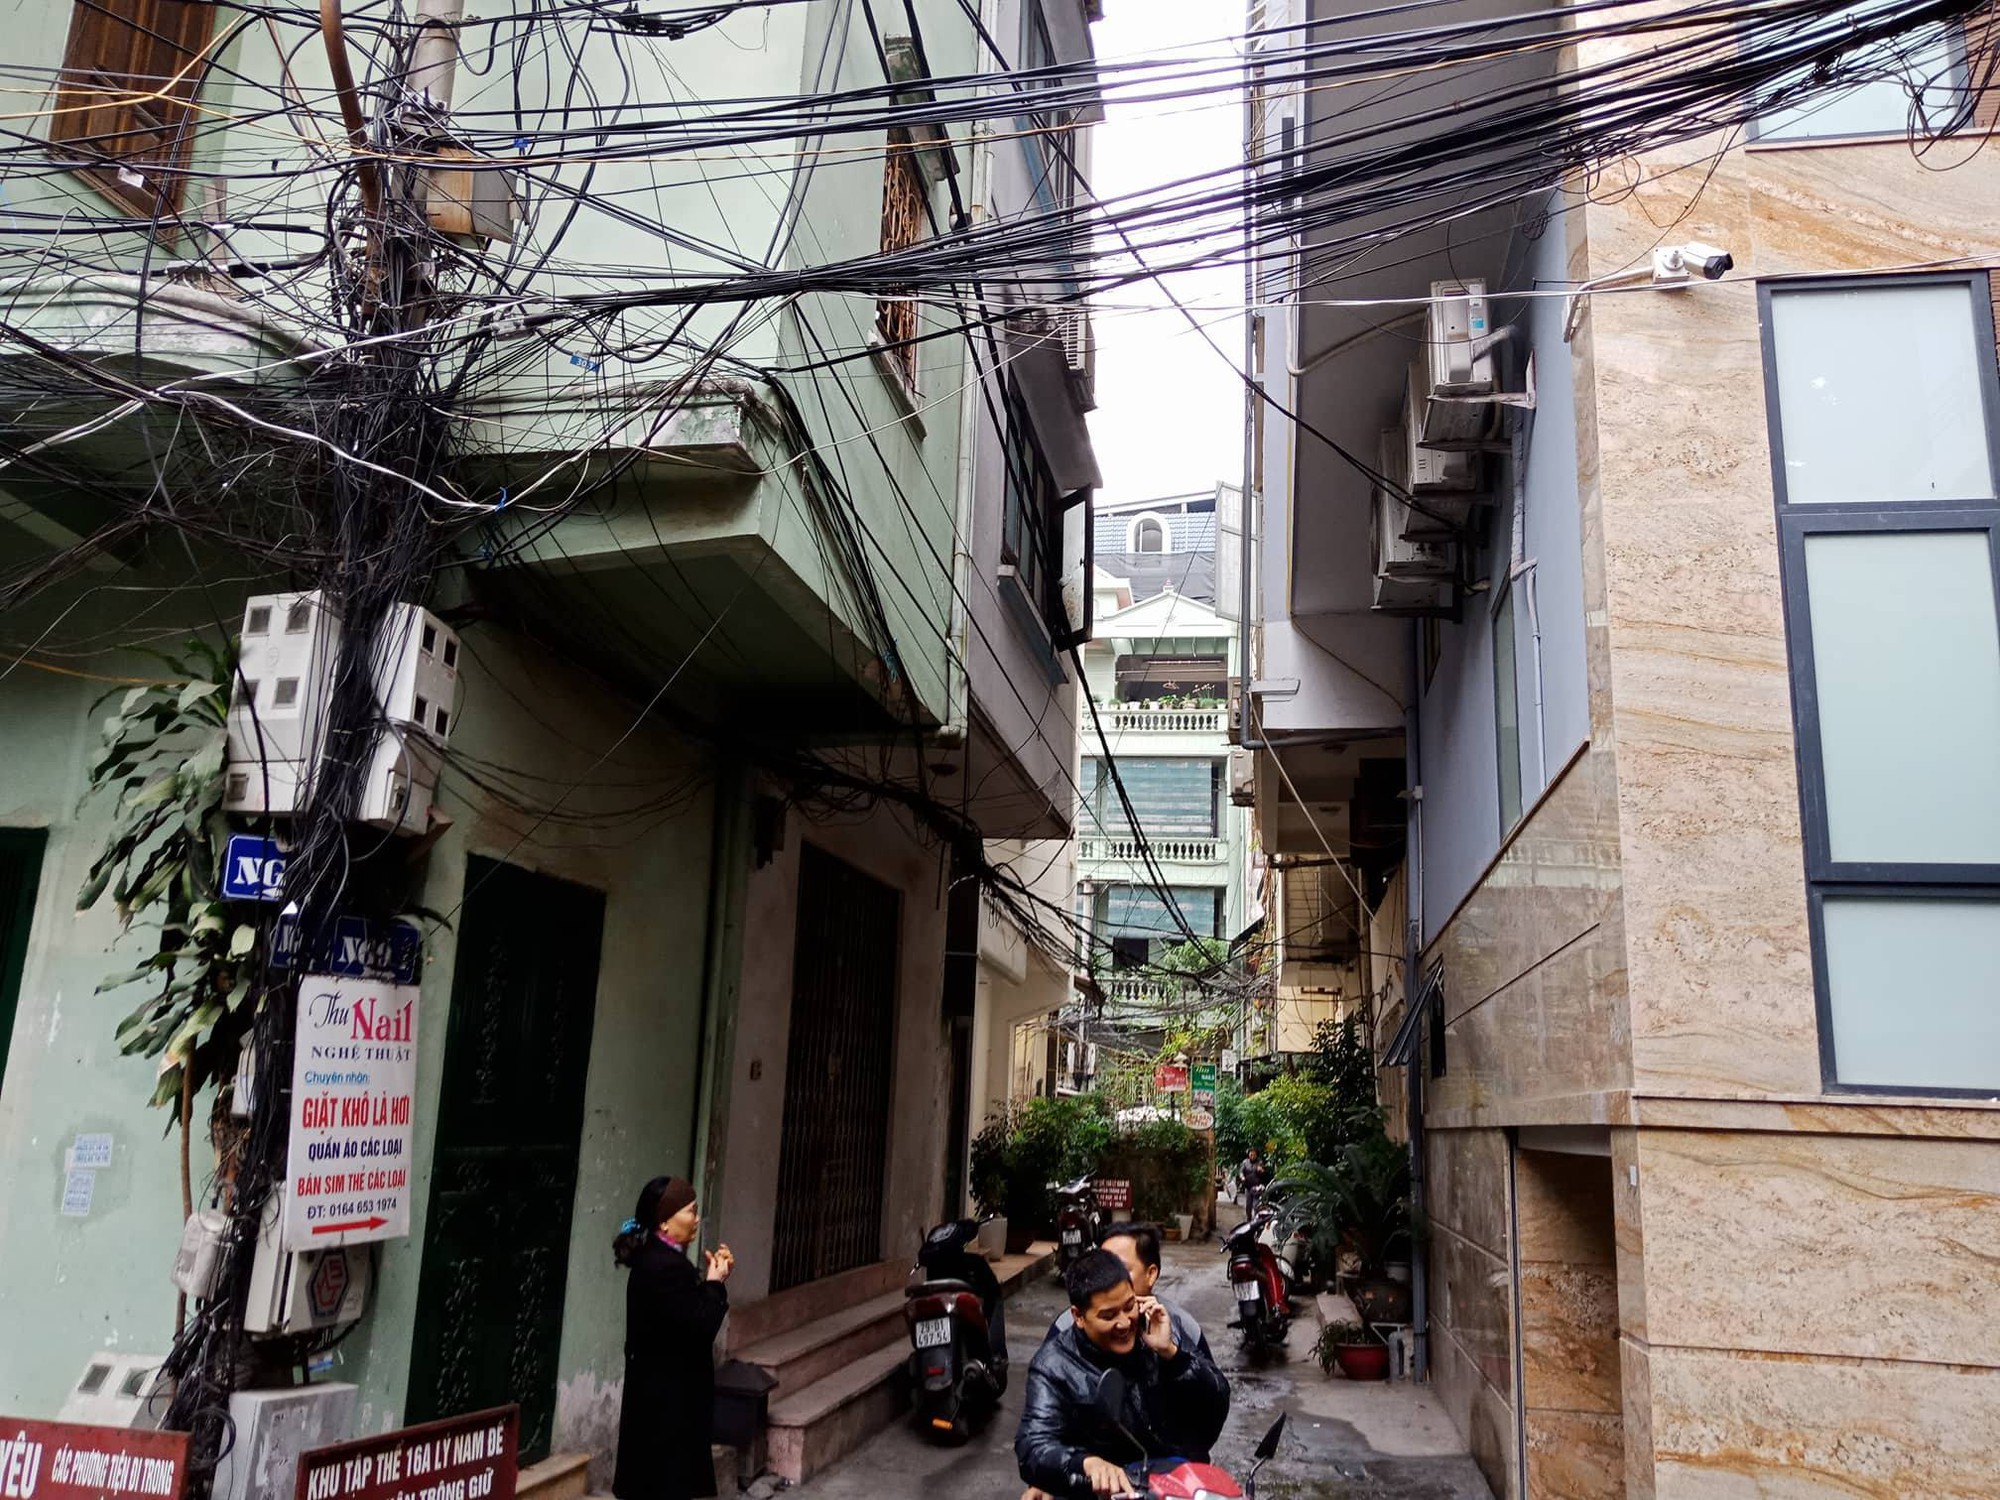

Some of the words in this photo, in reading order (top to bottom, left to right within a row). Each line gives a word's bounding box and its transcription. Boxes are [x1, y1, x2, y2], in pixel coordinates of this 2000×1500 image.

[309, 990, 349, 1028] Thu
[350, 998, 413, 1042] Nail
[302, 1091, 338, 1135] GIẶT
[360, 1135, 380, 1157] CÁC
[382, 1138, 403, 1159] LOẠI
[297, 1173, 321, 1197] BÁN
[324, 1174, 345, 1195] SIM
[367, 1167, 385, 1190] CÁC
[387, 1169, 406, 1191] LOẠI
[329, 1202, 354, 1217] 0164
[357, 1200, 374, 1214] 653
[377, 1198, 397, 1212] 1974
[52, 1443, 72, 1484] CÁC
[140, 1458, 175, 1496] TRONG
[307, 1463, 341, 1500] KHU
[406, 1443, 431, 1478] 16A
[453, 1430, 485, 1466] NAM
